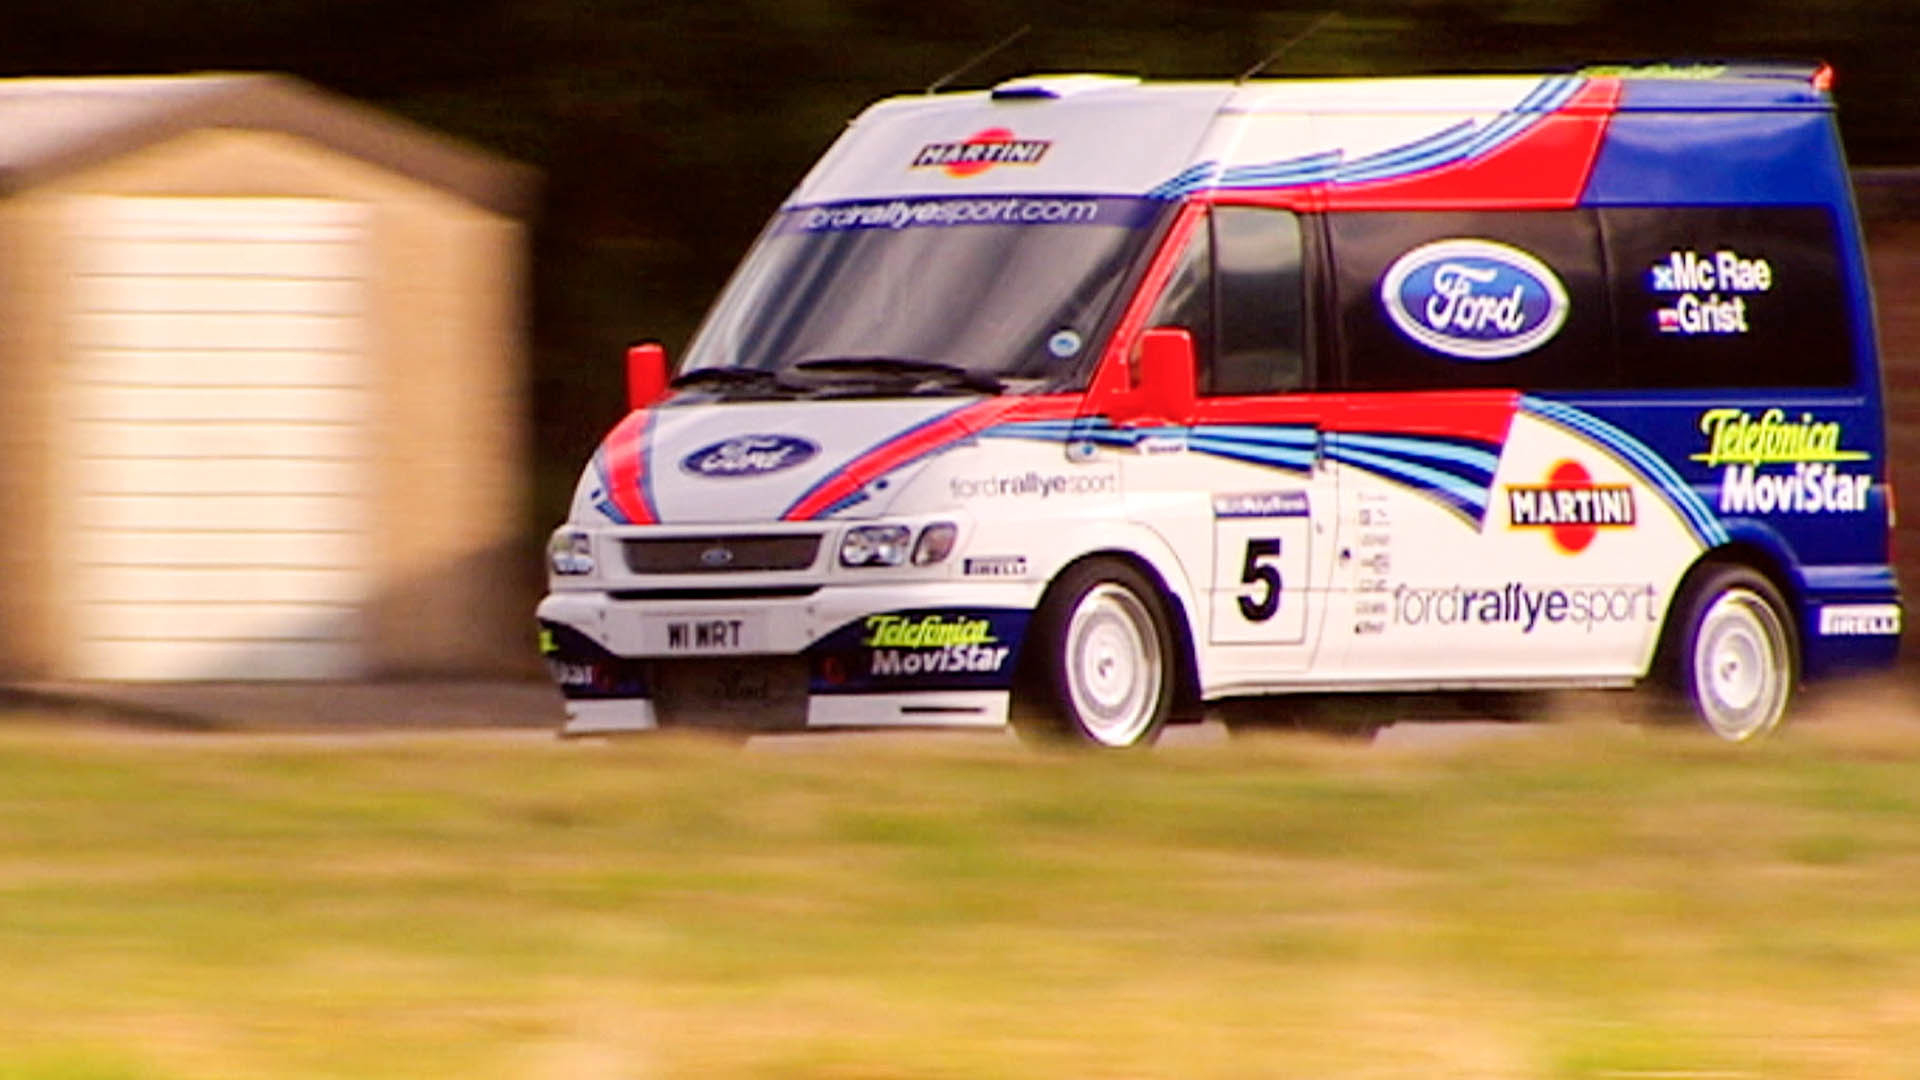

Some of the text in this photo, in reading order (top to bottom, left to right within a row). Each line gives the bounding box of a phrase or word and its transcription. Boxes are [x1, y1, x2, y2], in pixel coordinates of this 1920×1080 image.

[918, 142, 1043, 166] MARTINI
[1671, 249, 1772, 291] Mc Rae
[1425, 262, 1526, 332] Ford
[1677, 293, 1748, 333] Grist
[699, 435, 796, 472] Ford
[1512, 487, 1632, 524] MARTINI
[1720, 461, 1872, 513] MoviStar
[1236, 536, 1282, 623] 5
[1393, 582, 1658, 633] fordrallyesport
[695, 620, 743, 648] WRT
[871, 644, 1010, 675] MoviStar
